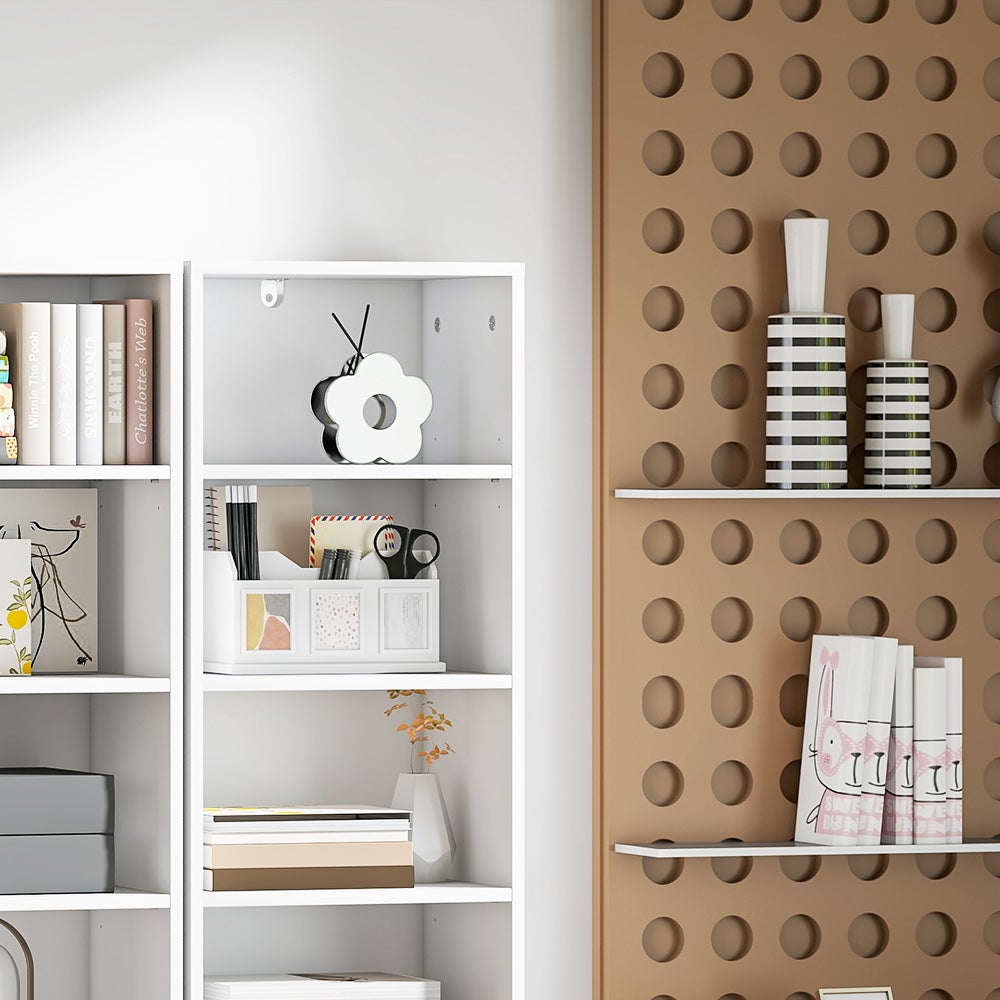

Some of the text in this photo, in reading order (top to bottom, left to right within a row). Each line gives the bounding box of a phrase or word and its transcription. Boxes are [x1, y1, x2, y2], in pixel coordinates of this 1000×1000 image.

[29, 331, 40, 429] Winnie The Pooh
[135, 318, 148, 353] Web
[85, 336, 97, 438] UNICORNS
[108, 342, 122, 424] EARTH
